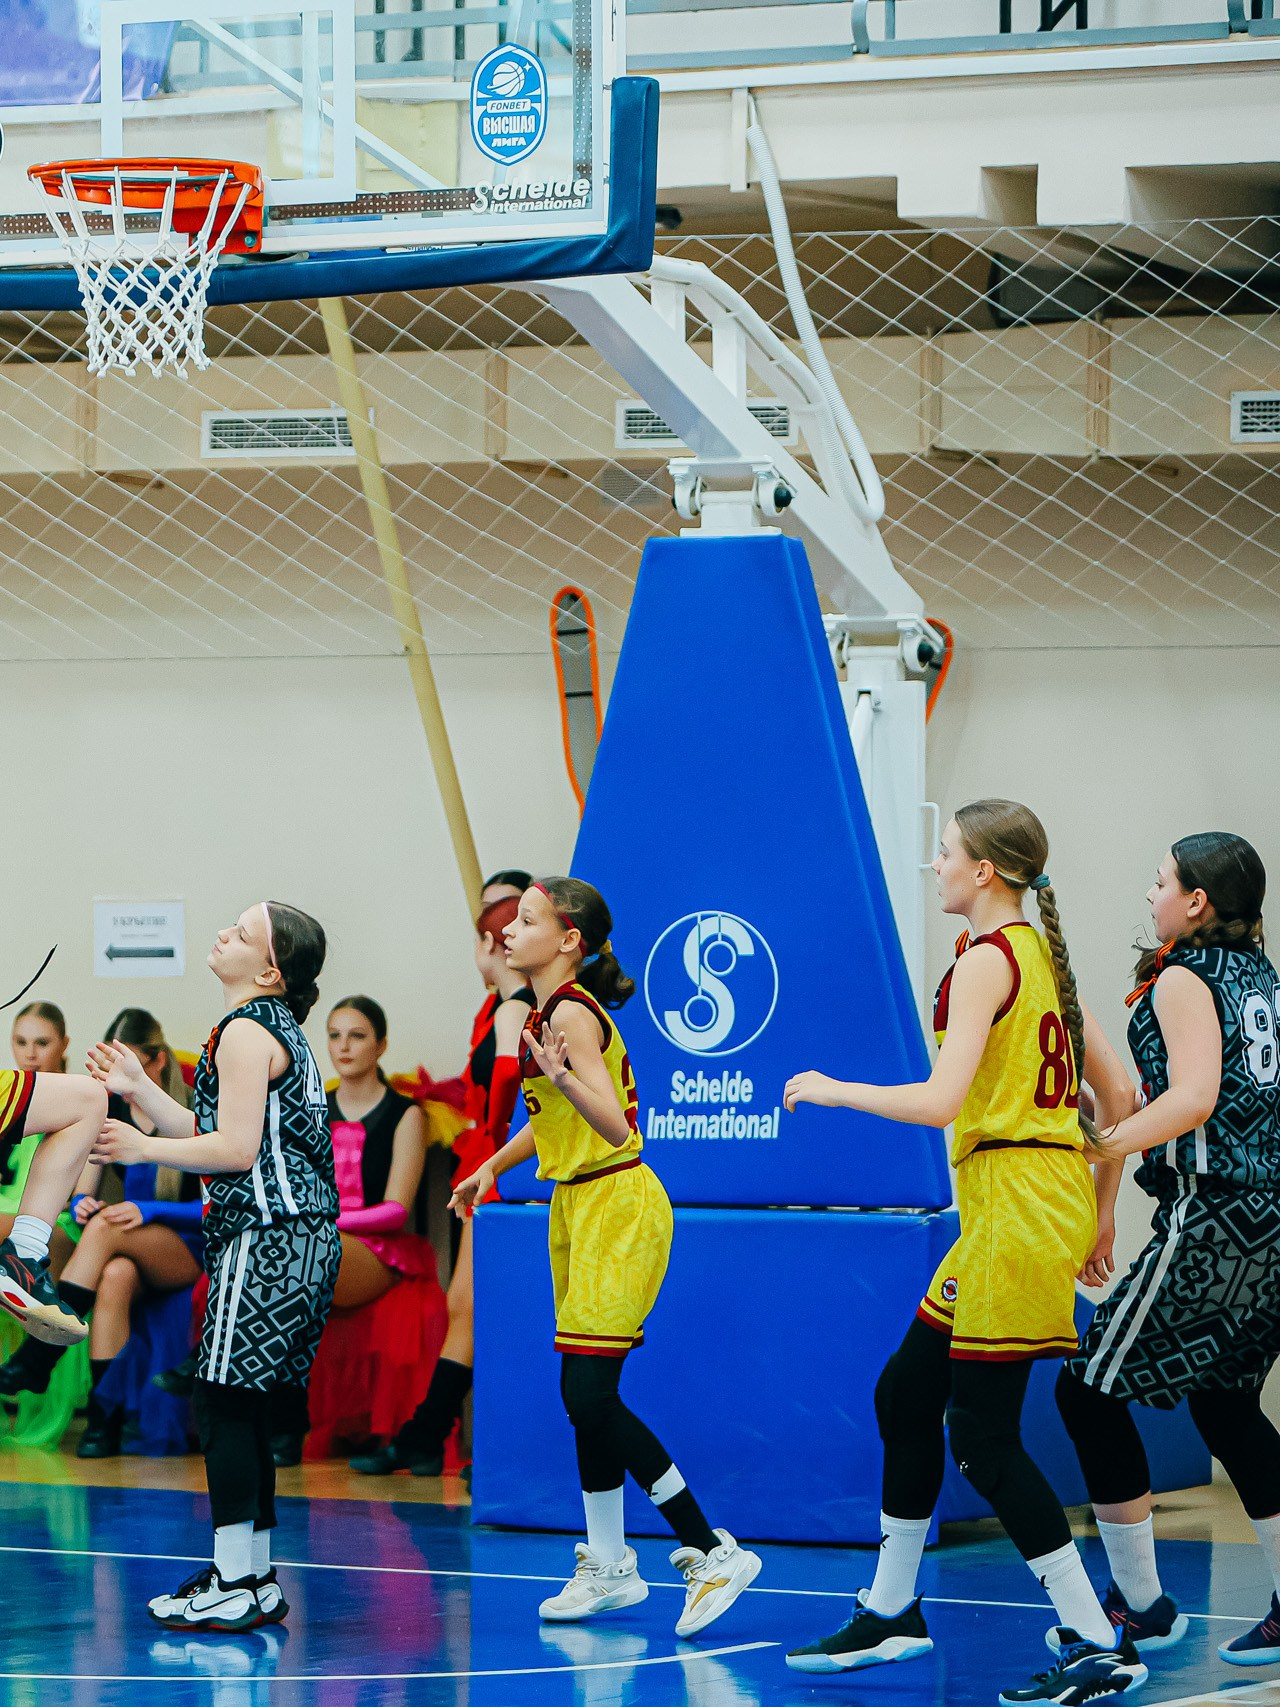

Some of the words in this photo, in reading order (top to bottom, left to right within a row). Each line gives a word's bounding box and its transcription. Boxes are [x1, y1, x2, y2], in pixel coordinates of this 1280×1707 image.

[490, 100, 528, 112] FONBET
[483, 115, 536, 136] ВЫСШАЯ
[492, 137, 527, 148] ЛИГА
[470, 176, 590, 214] Schelde
[490, 195, 587, 213] international
[671, 1070, 754, 1104] Schelde
[646, 1106, 780, 1140] International
